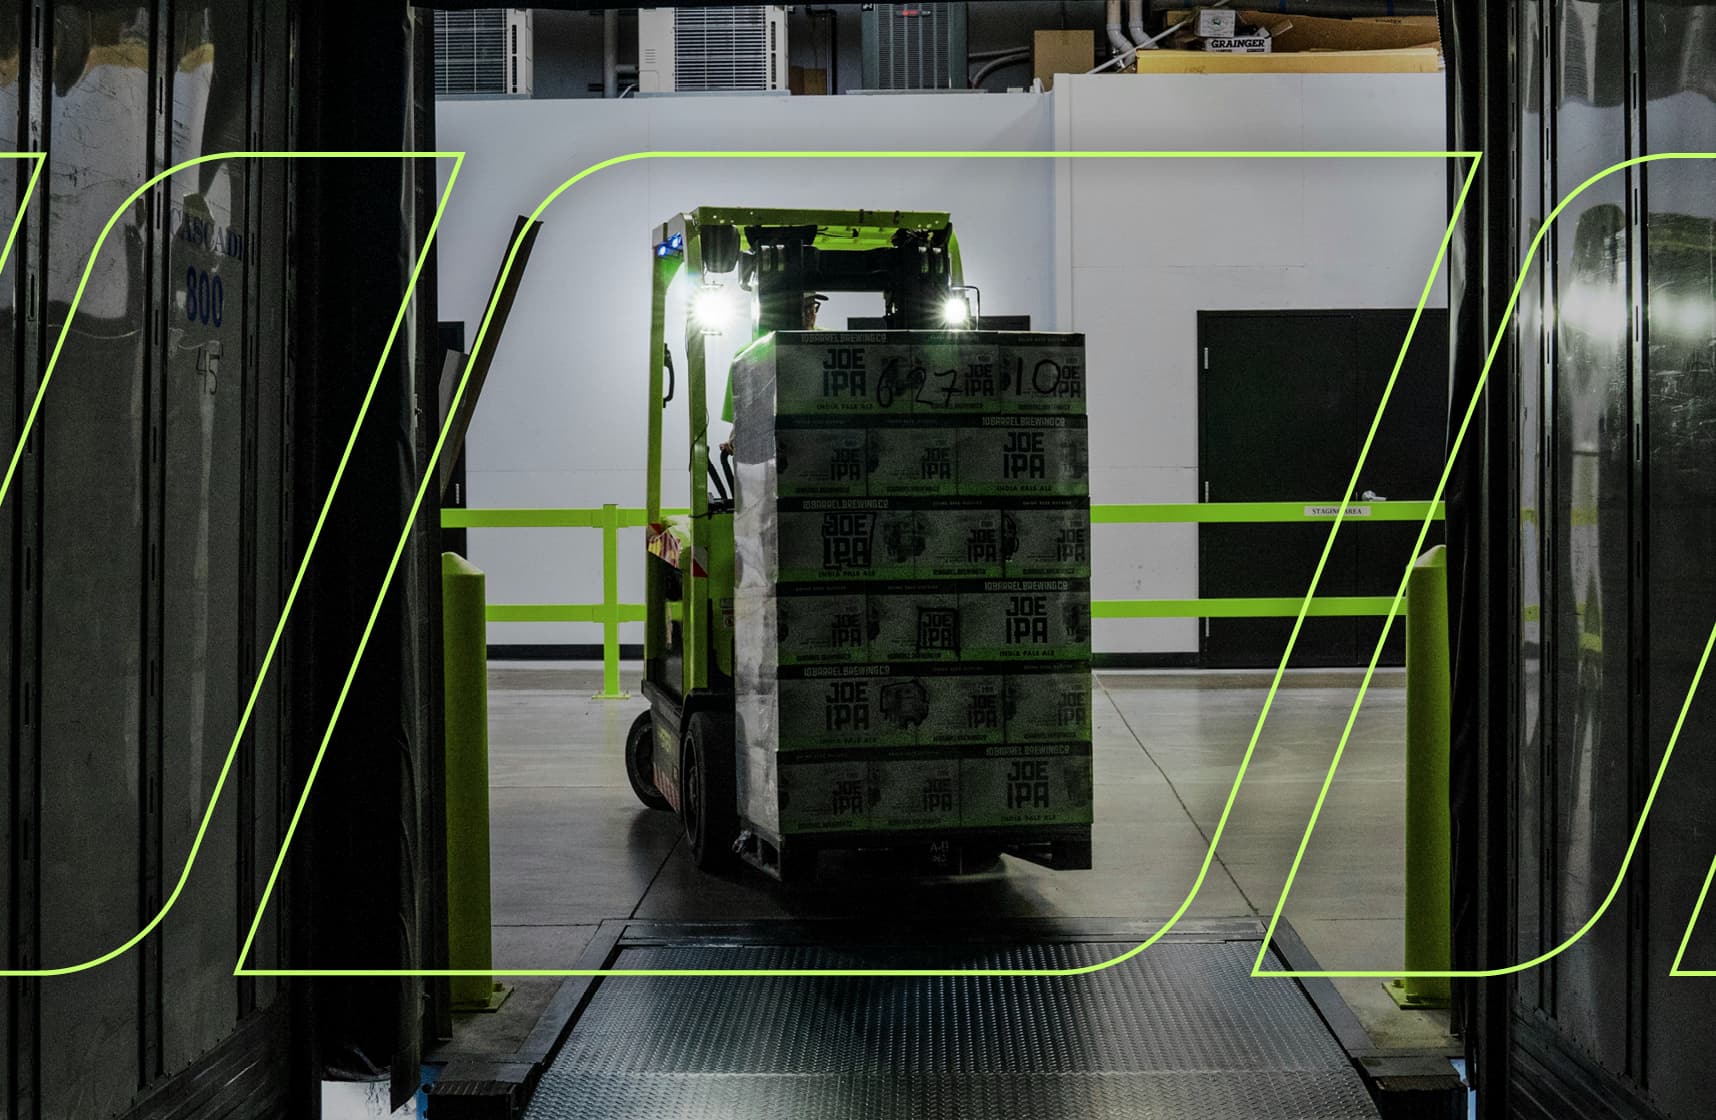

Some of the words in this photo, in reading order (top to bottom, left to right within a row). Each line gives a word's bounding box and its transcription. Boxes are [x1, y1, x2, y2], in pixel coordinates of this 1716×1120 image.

[1211, 39, 1265, 48] GRAINGER
[186, 265, 223, 328] 800
[823, 348, 865, 369] JOE
[965, 364, 993, 378] JOE
[1055, 366, 1080, 379] OE
[823, 371, 866, 397] IPA
[965, 380, 994, 396] IPA
[1004, 432, 1045, 452] JOE
[831, 448, 860, 462] JOE
[922, 448, 950, 462] JOE
[831, 463, 860, 480] IPA
[922, 463, 951, 480] IPA
[1003, 454, 1045, 479] IPA
[825, 514, 868, 536] JOE
[968, 529, 996, 543] JOE
[1057, 529, 1084, 543] JOE
[825, 537, 870, 565] IPA
[968, 544, 996, 562] IPA
[1057, 544, 1085, 562] IPA
[1006, 596, 1047, 616] JOE
[832, 614, 860, 627] JOE
[923, 614, 952, 627] JOE
[832, 628, 861, 647] IPA
[923, 629, 953, 646] IPA
[1005, 618, 1048, 644] IPA
[826, 681, 869, 703] JOE
[1057, 692, 1086, 706] JOE
[968, 695, 996, 709] JOE
[826, 704, 869, 730] IPA
[968, 710, 997, 728] IPA
[1057, 708, 1086, 726] IPA
[1007, 761, 1049, 781] JOE
[833, 781, 861, 795] JOE
[924, 778, 951, 793] JOE
[923, 794, 952, 812] IPA
[1007, 783, 1049, 809] IPA
[833, 796, 862, 815] IPA
